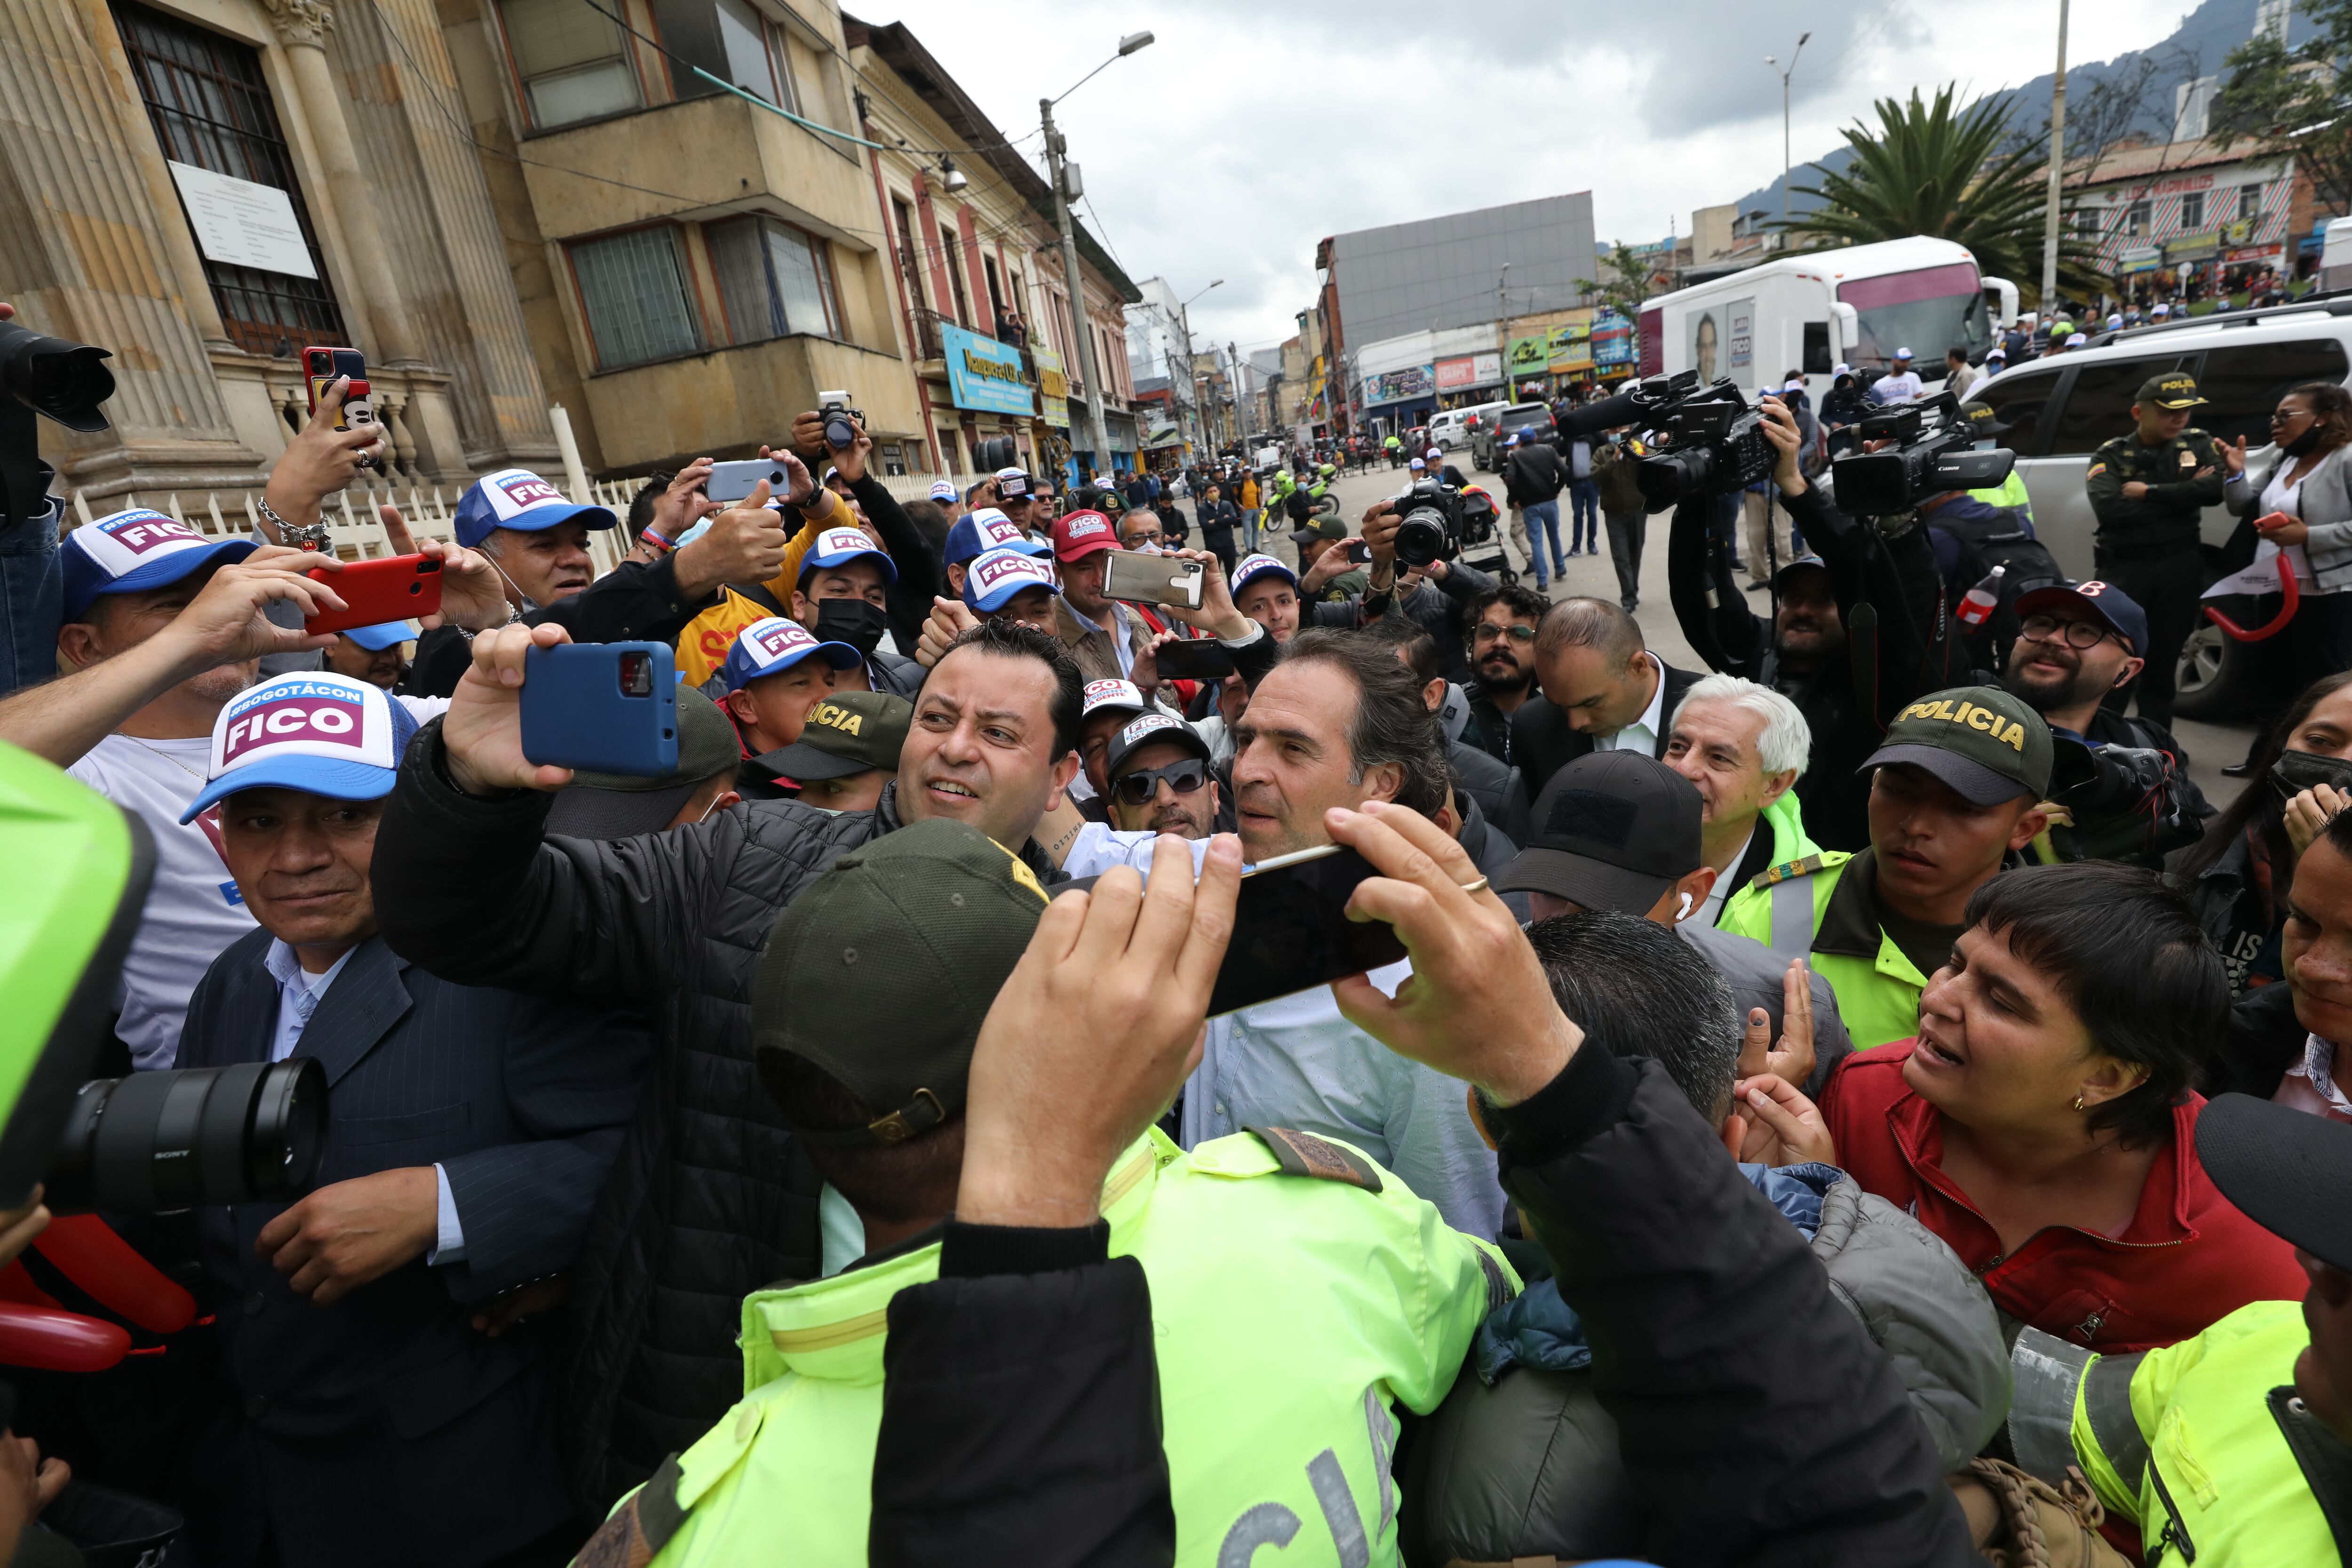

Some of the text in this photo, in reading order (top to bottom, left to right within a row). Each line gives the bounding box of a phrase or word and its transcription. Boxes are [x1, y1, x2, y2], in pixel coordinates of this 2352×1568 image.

[930, 485, 949, 493] FICO
[1071, 517, 1100, 530] FICO
[982, 559, 1033, 582] FICO
[2076, 581, 2107, 597] B
[1936, 598, 1945, 641] Canon
[230, 683, 360, 717] #BOGOTÁCON
[1085, 692, 1126, 709] LA GENTE
[227, 708, 353, 754] FICO
[1131, 717, 1175, 733] FICO
[1899, 700, 2024, 751] POLICIA
[1054, 821, 1082, 850] EMILIO
[2232, 931, 2263, 960] IS
[154, 1149, 191, 1160] SONY
